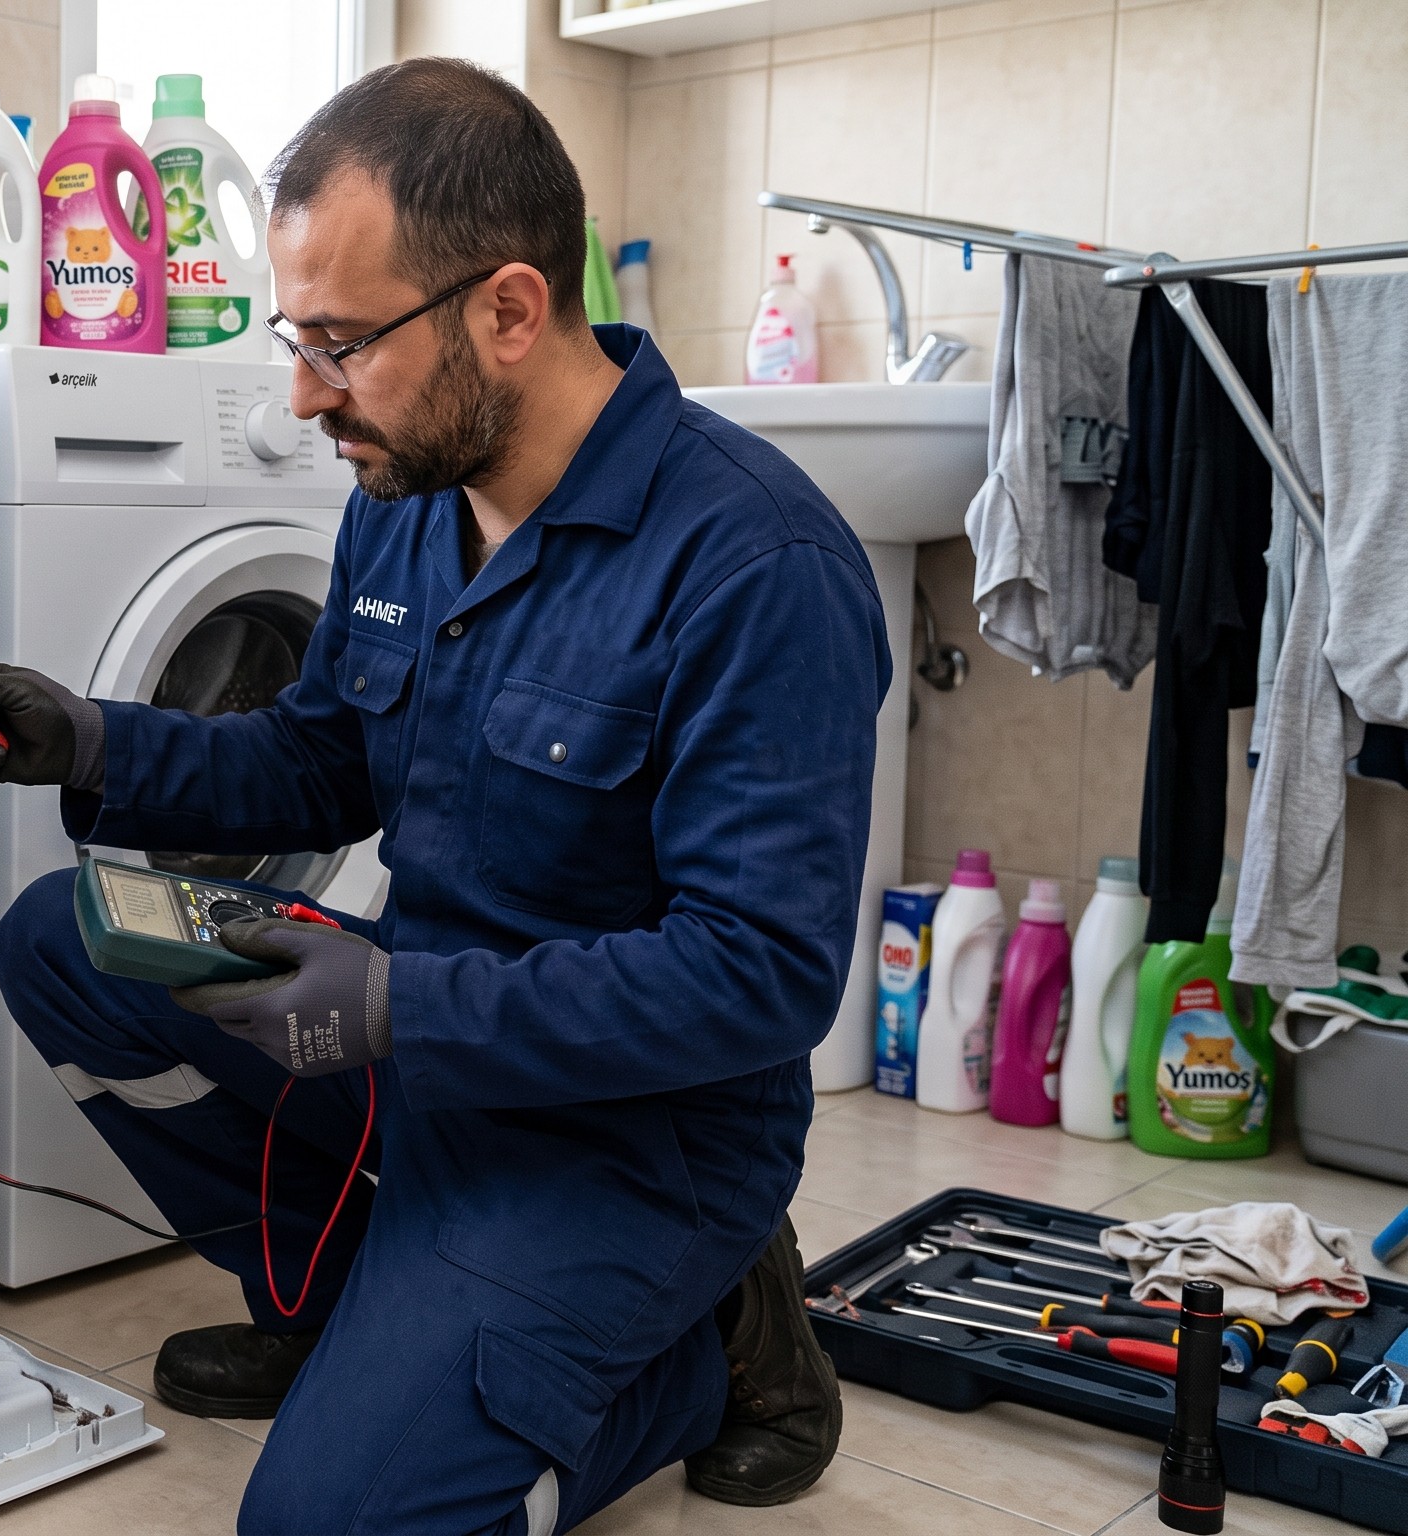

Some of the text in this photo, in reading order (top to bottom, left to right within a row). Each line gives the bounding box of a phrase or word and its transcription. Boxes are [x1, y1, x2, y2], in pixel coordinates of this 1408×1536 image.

[46, 259, 134, 288] Yumoş
[166, 261, 227, 284] RIEL
[353, 595, 408, 626] AHMET
